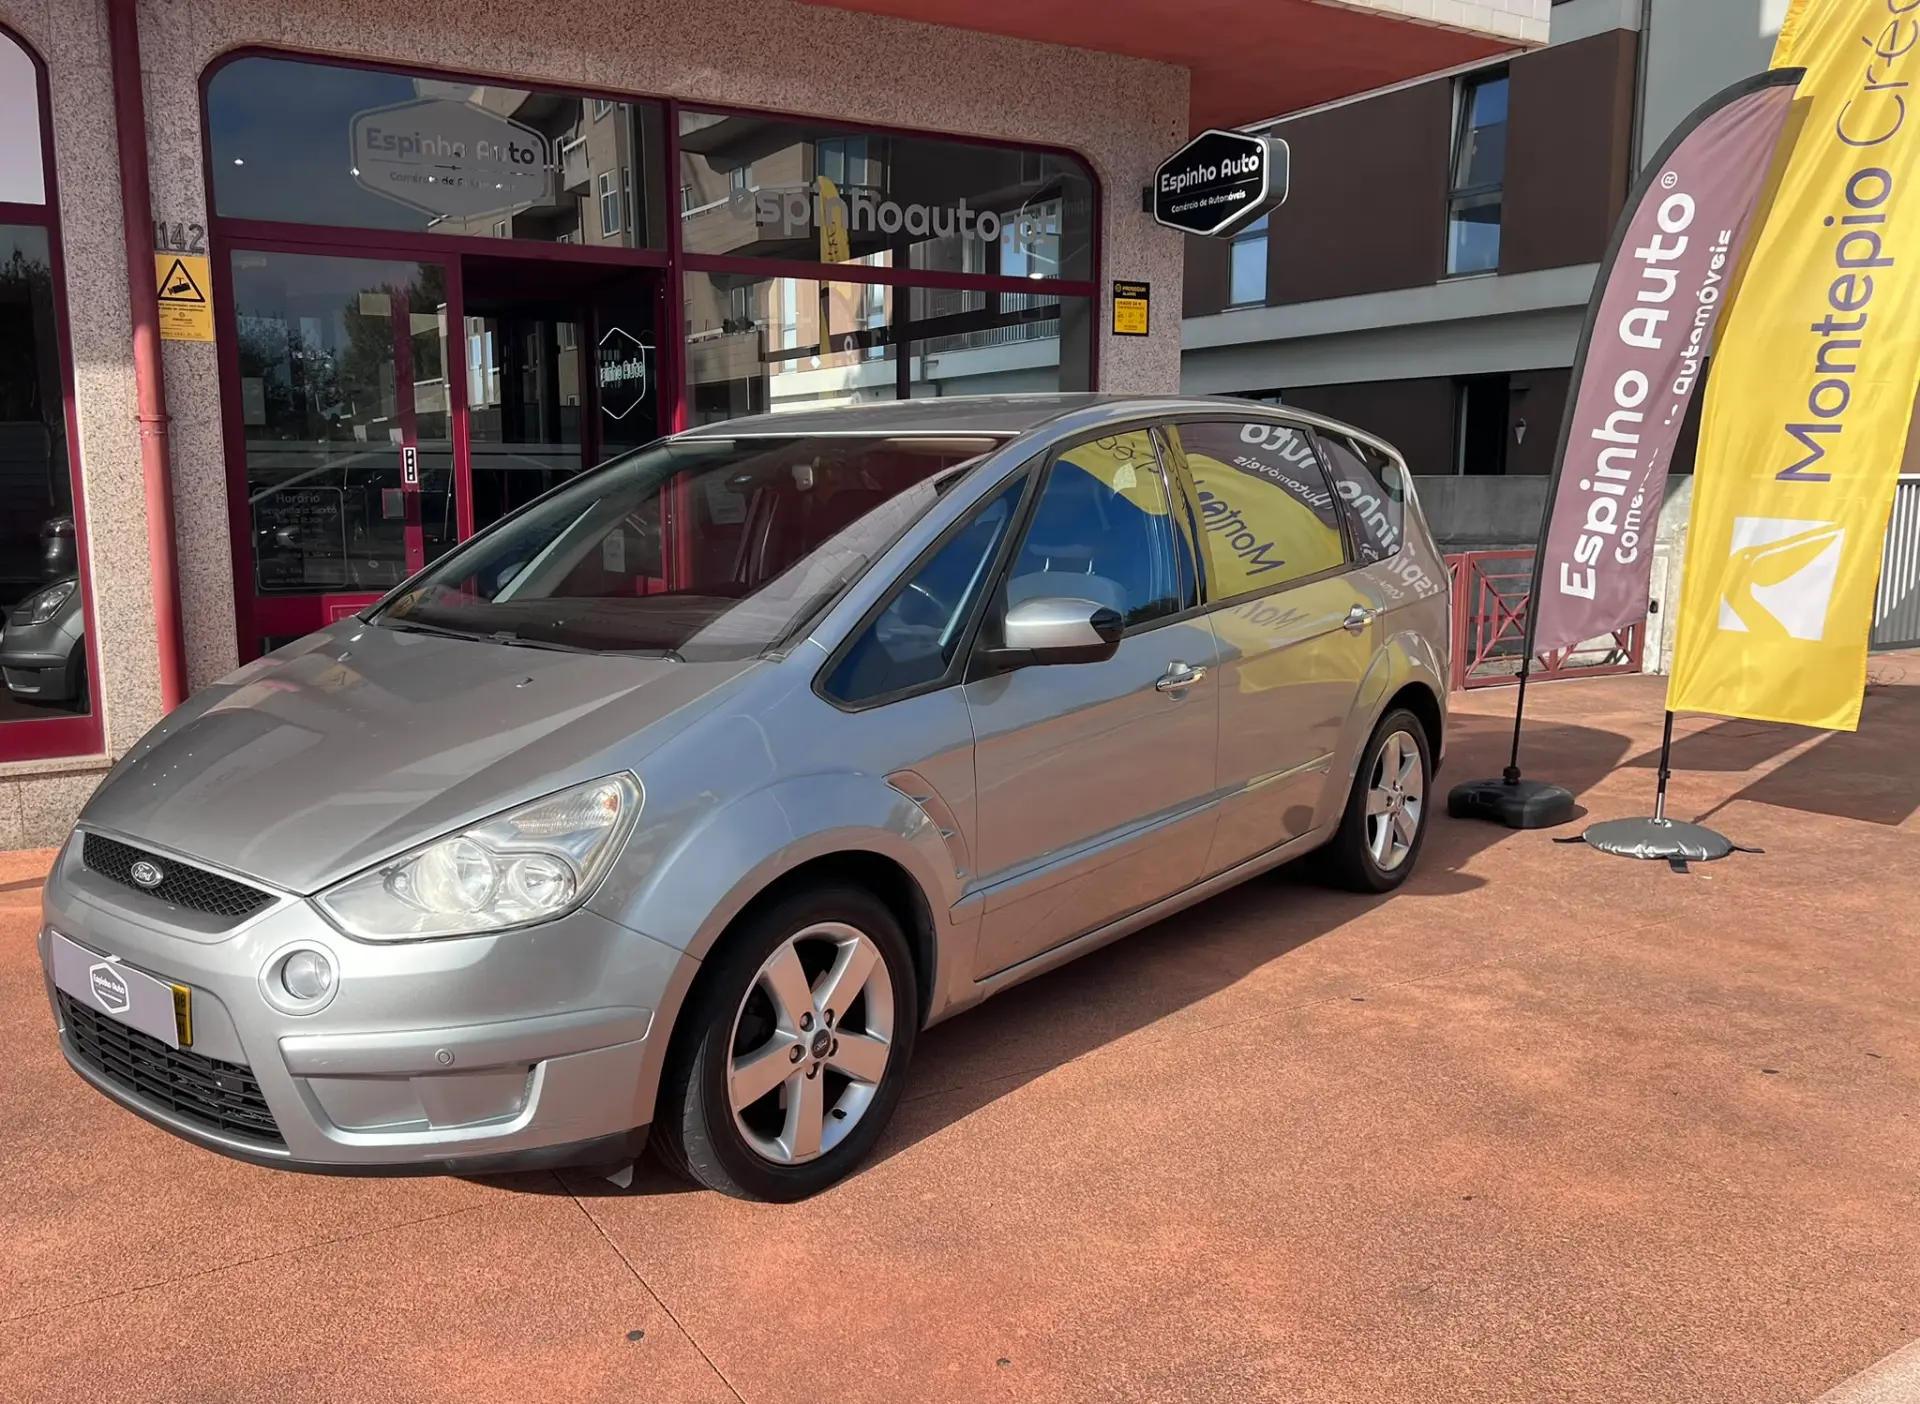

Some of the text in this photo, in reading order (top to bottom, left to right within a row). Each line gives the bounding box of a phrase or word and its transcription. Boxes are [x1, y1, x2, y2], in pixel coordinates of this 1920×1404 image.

[366, 127, 536, 165] Espinho Auto
[442, 176, 454, 186] de
[1161, 153, 1260, 193] Espinho Auto
[1775, 0, 1920, 483] Montepio Cré
[1559, 369, 1650, 601] Espinho
